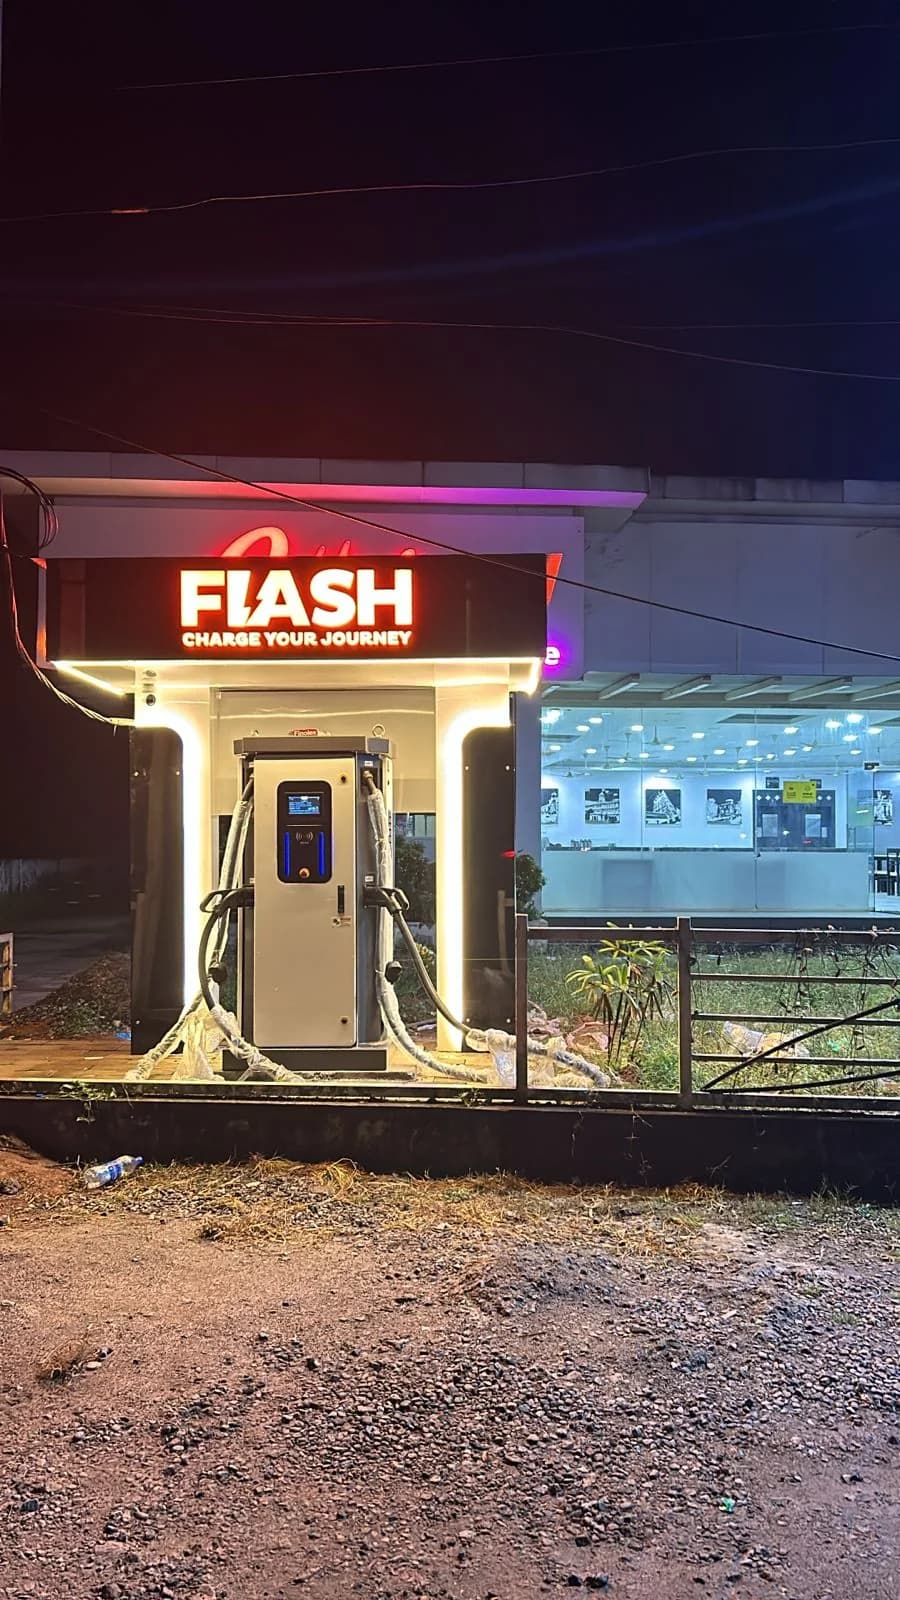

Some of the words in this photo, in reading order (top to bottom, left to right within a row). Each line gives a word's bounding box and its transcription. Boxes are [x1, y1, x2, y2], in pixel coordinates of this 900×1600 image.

[180, 568, 413, 628] FLASH
[182, 631, 261, 647] CHARGE
[264, 631, 318, 646] YOUR
[320, 630, 412, 646] JOURNEY
